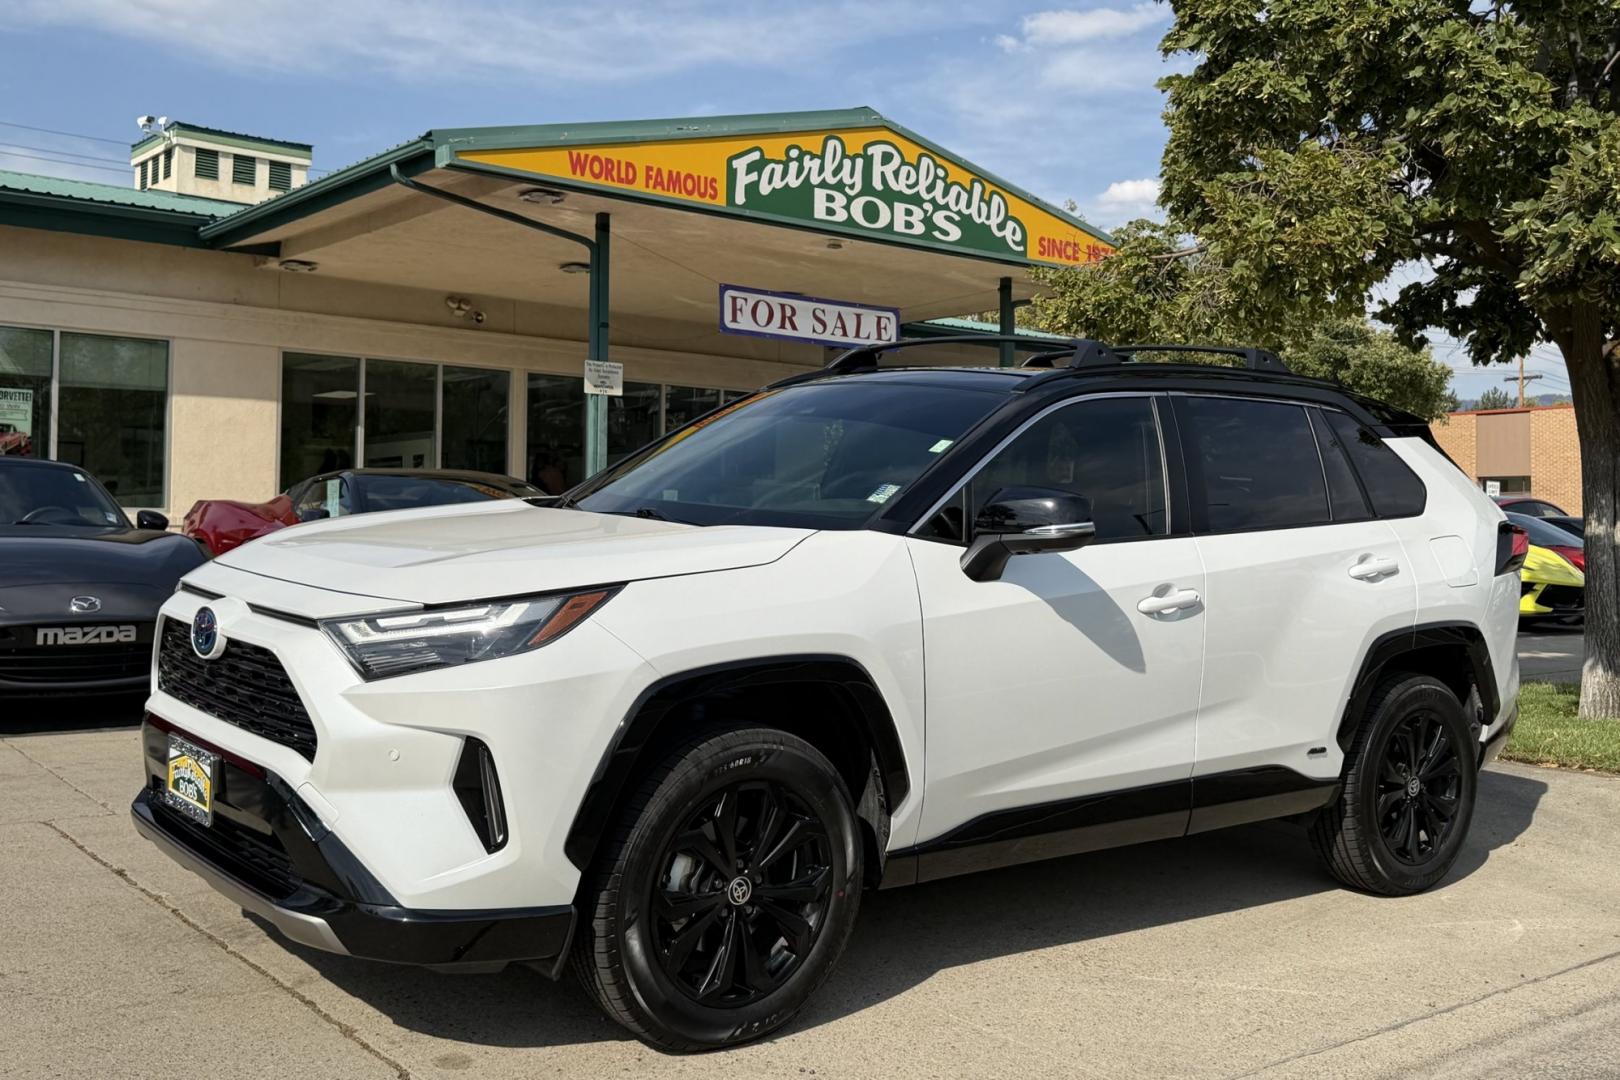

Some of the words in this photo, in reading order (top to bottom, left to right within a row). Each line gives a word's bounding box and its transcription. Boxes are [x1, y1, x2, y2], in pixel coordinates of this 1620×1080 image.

[568, 150, 637, 186] WORLD
[645, 165, 719, 201] FAMOUS
[732, 138, 864, 206] Fairly
[867, 143, 1025, 252] Reliable
[813, 186, 962, 242] BOB'S
[1038, 236, 1080, 262] SINCE
[728, 295, 799, 332] FOR
[811, 307, 893, 343] SALE
[36, 625, 137, 646] mazda
